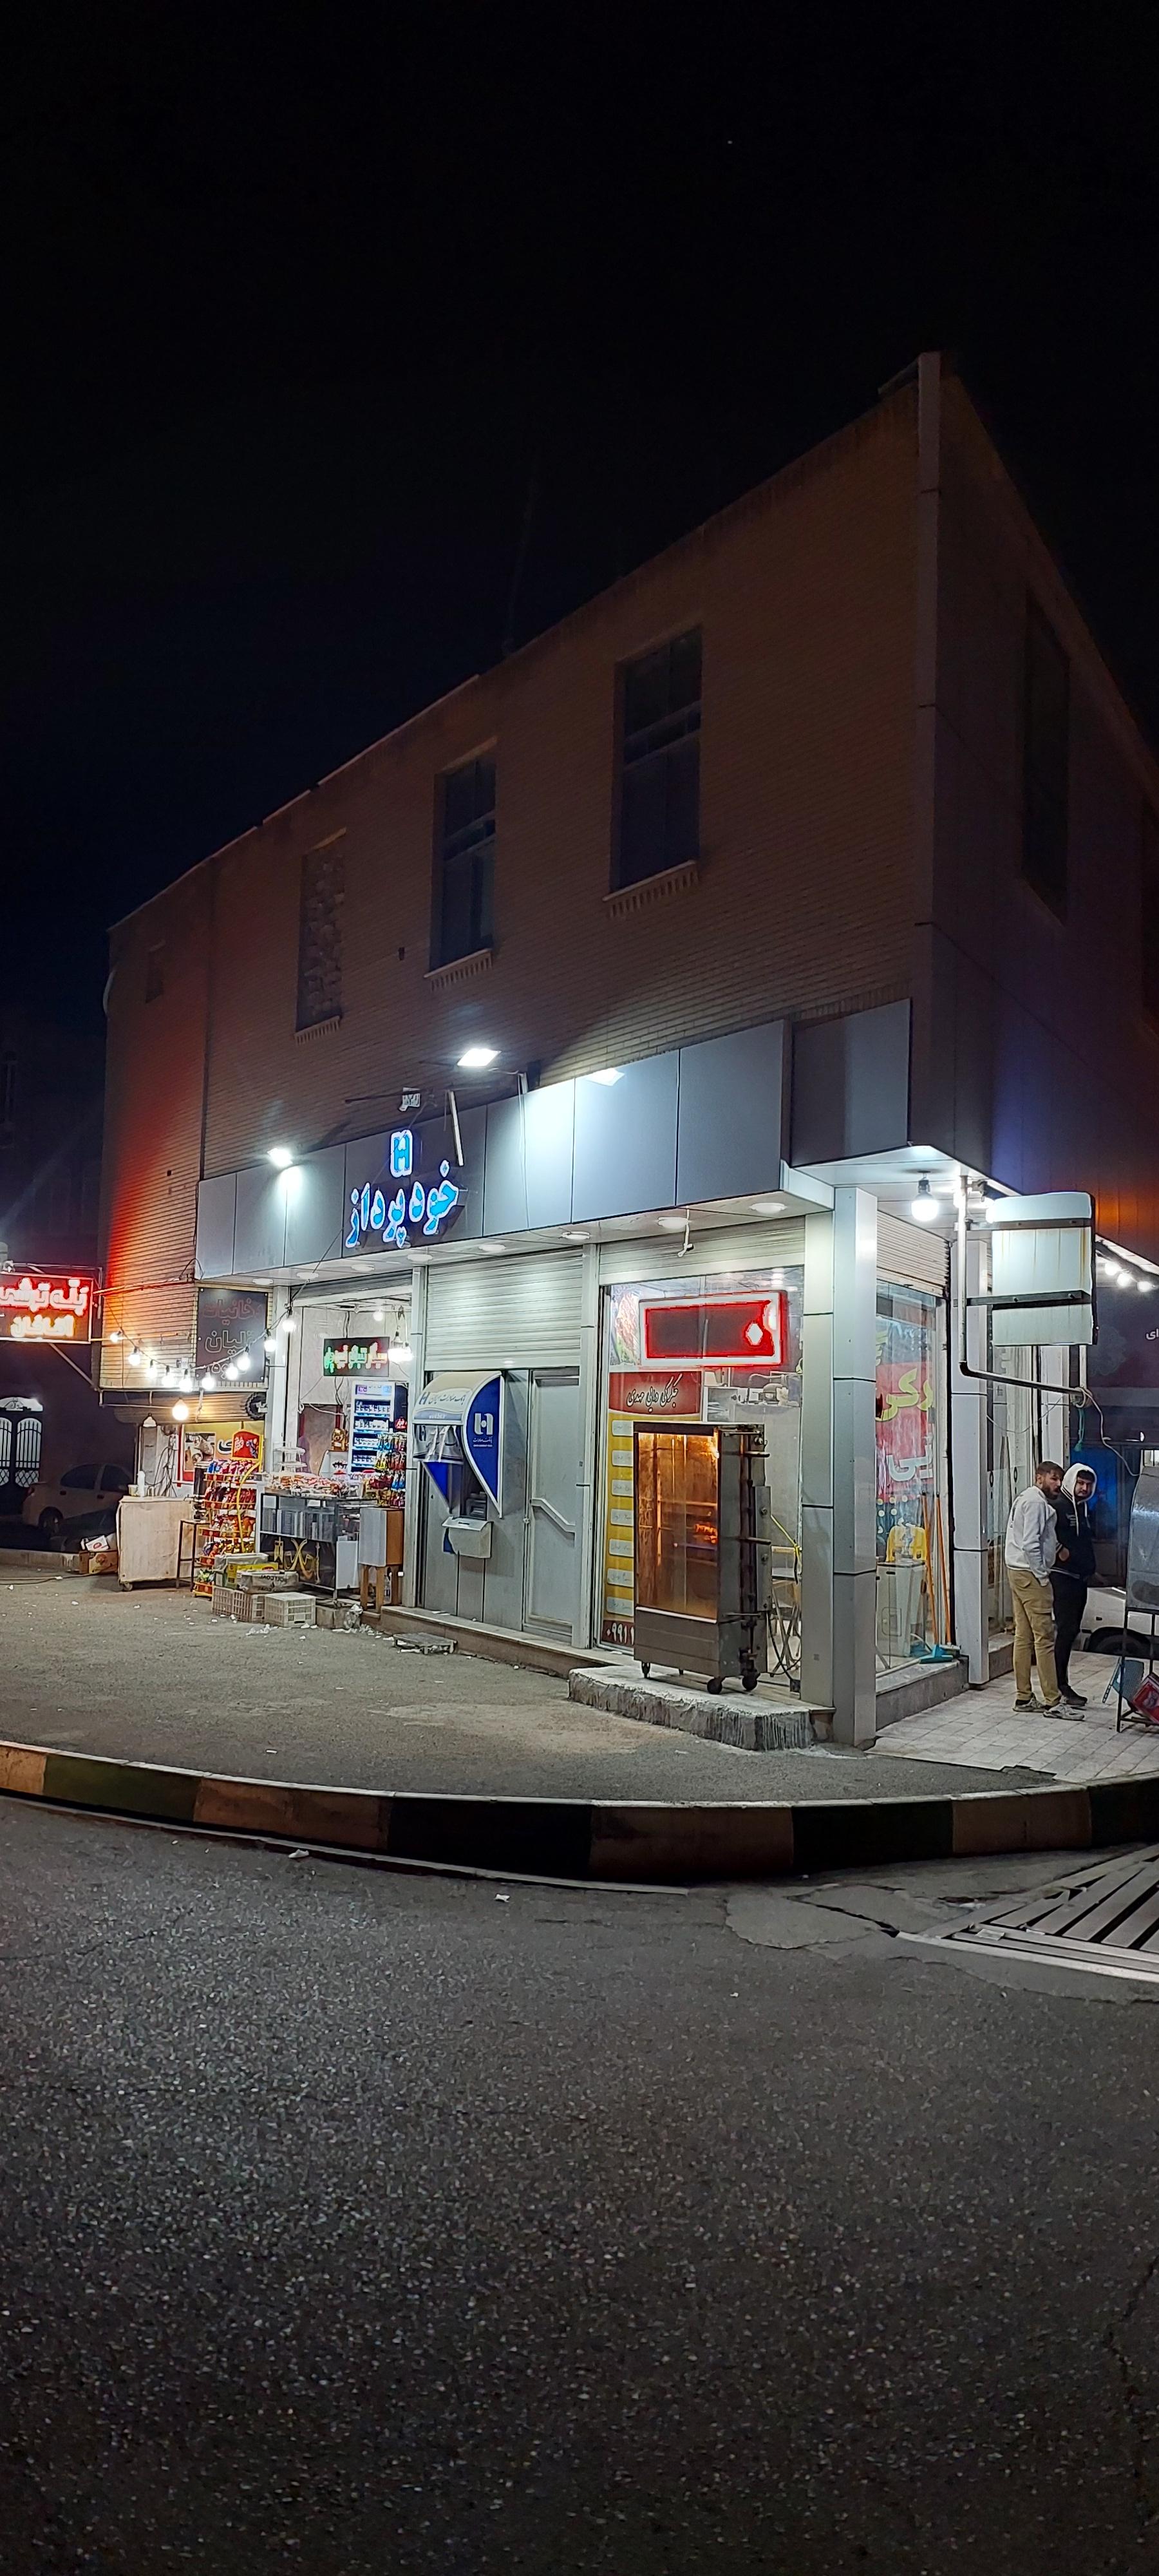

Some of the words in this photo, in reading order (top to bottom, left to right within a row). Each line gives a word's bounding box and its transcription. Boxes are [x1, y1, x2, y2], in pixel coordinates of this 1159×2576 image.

[1145, 1328, 1159, 1340] ای
[626, 1388, 645, 1407] مهدی
[660, 1372, 683, 1408] جگرکی
